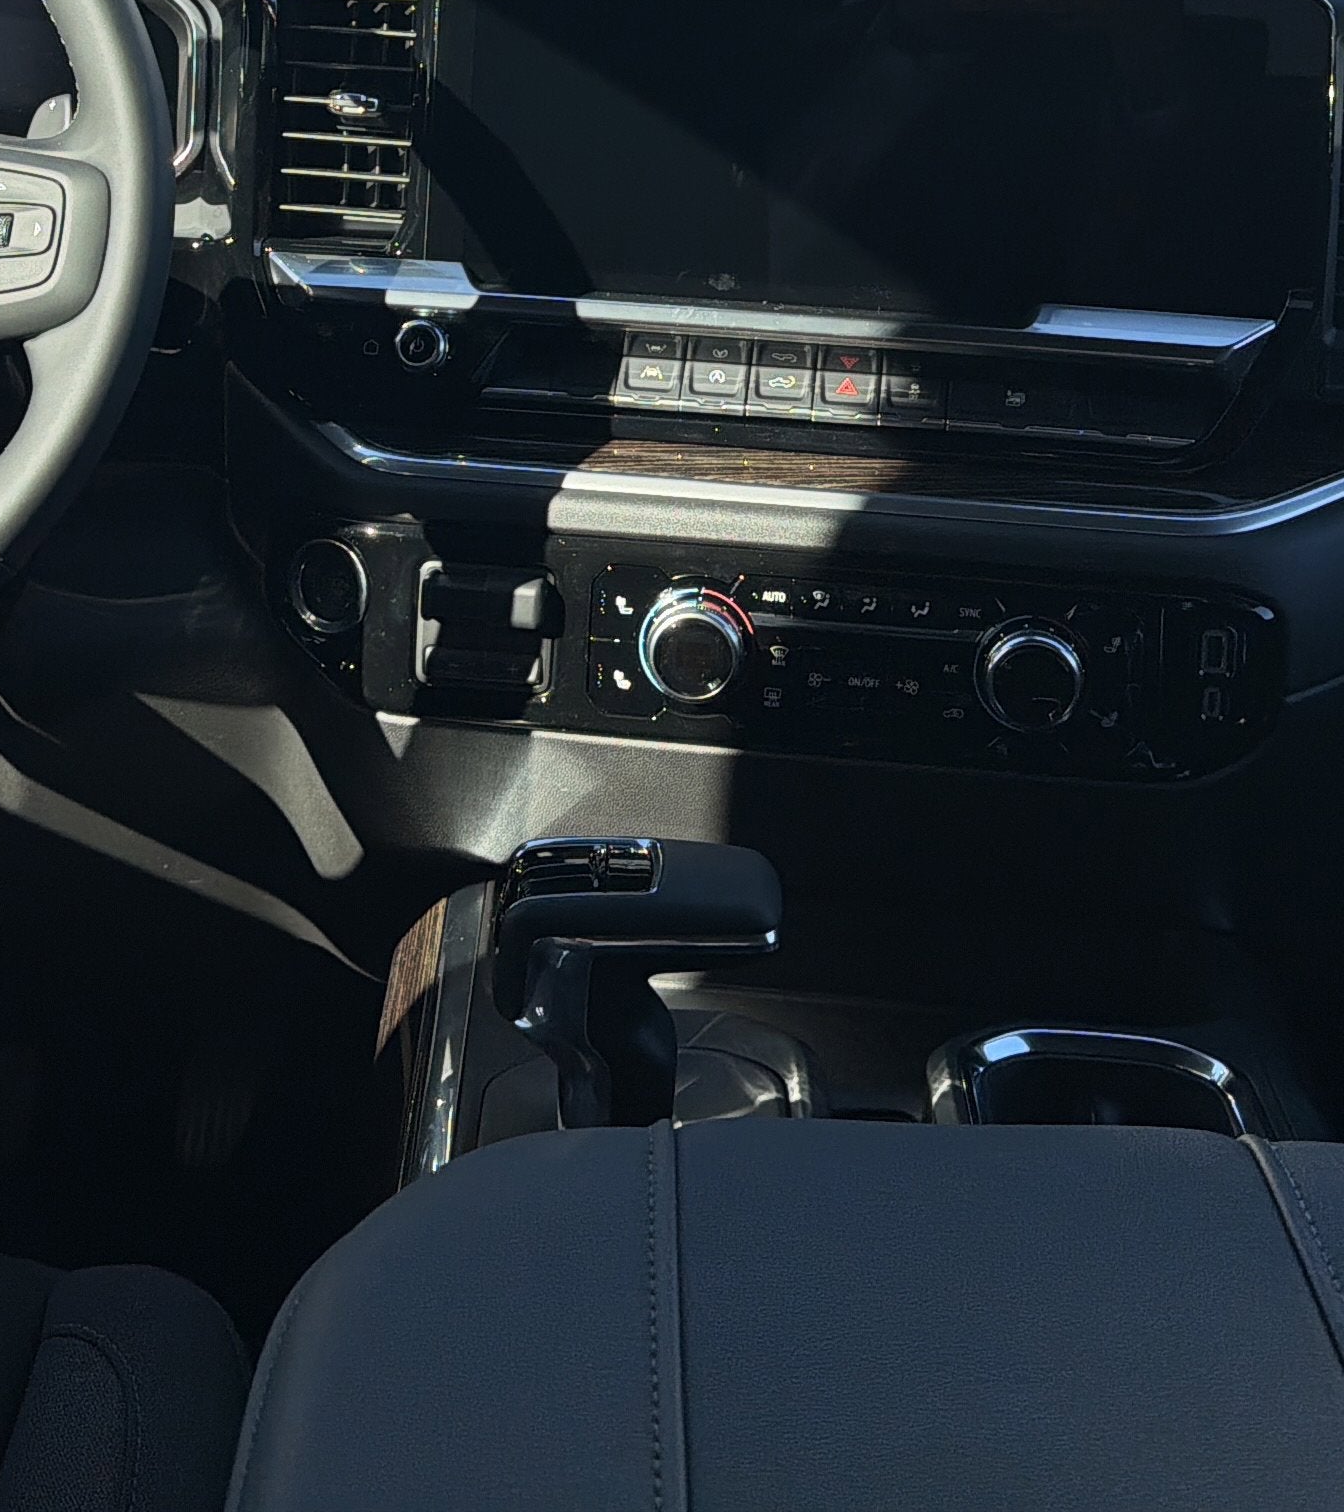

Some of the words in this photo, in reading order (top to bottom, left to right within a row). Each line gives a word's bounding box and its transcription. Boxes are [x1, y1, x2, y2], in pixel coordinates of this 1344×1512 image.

[762, 590, 786, 604] AUTO
[959, 607, 982, 619] SYNC
[943, 664, 960, 674] A/C
[847, 676, 881, 689] ON/OFF
